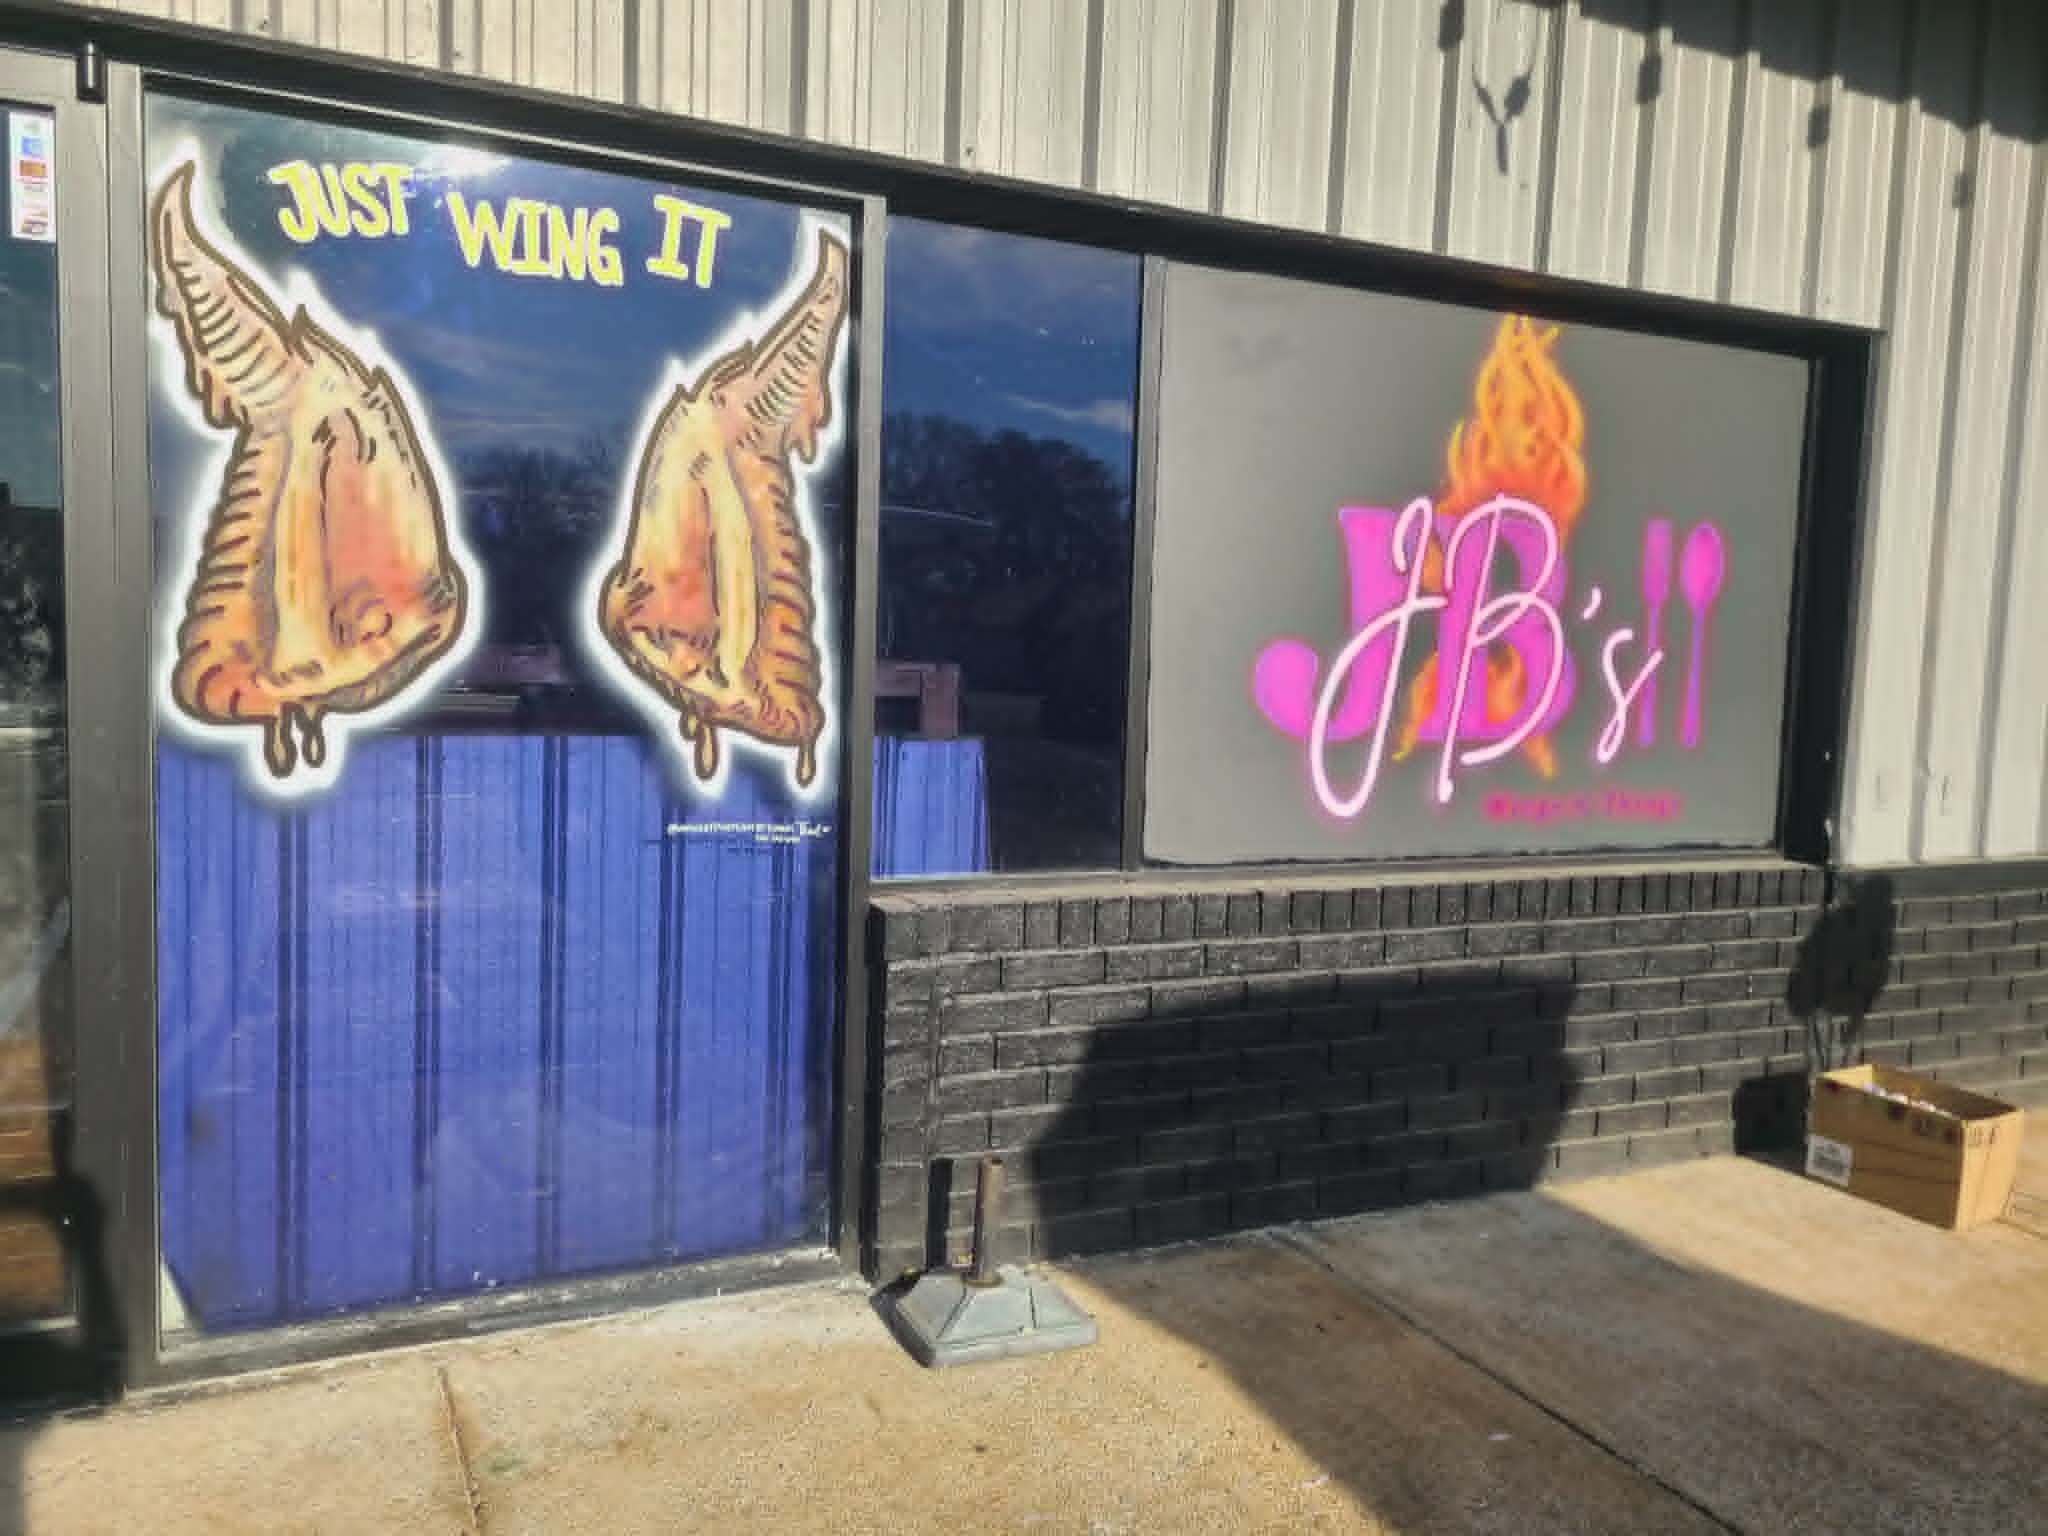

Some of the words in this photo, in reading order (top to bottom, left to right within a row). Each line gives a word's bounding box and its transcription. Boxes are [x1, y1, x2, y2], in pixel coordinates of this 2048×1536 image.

[267, 159, 411, 242] JUST
[446, 190, 624, 286] WING
[645, 193, 732, 288] IT
